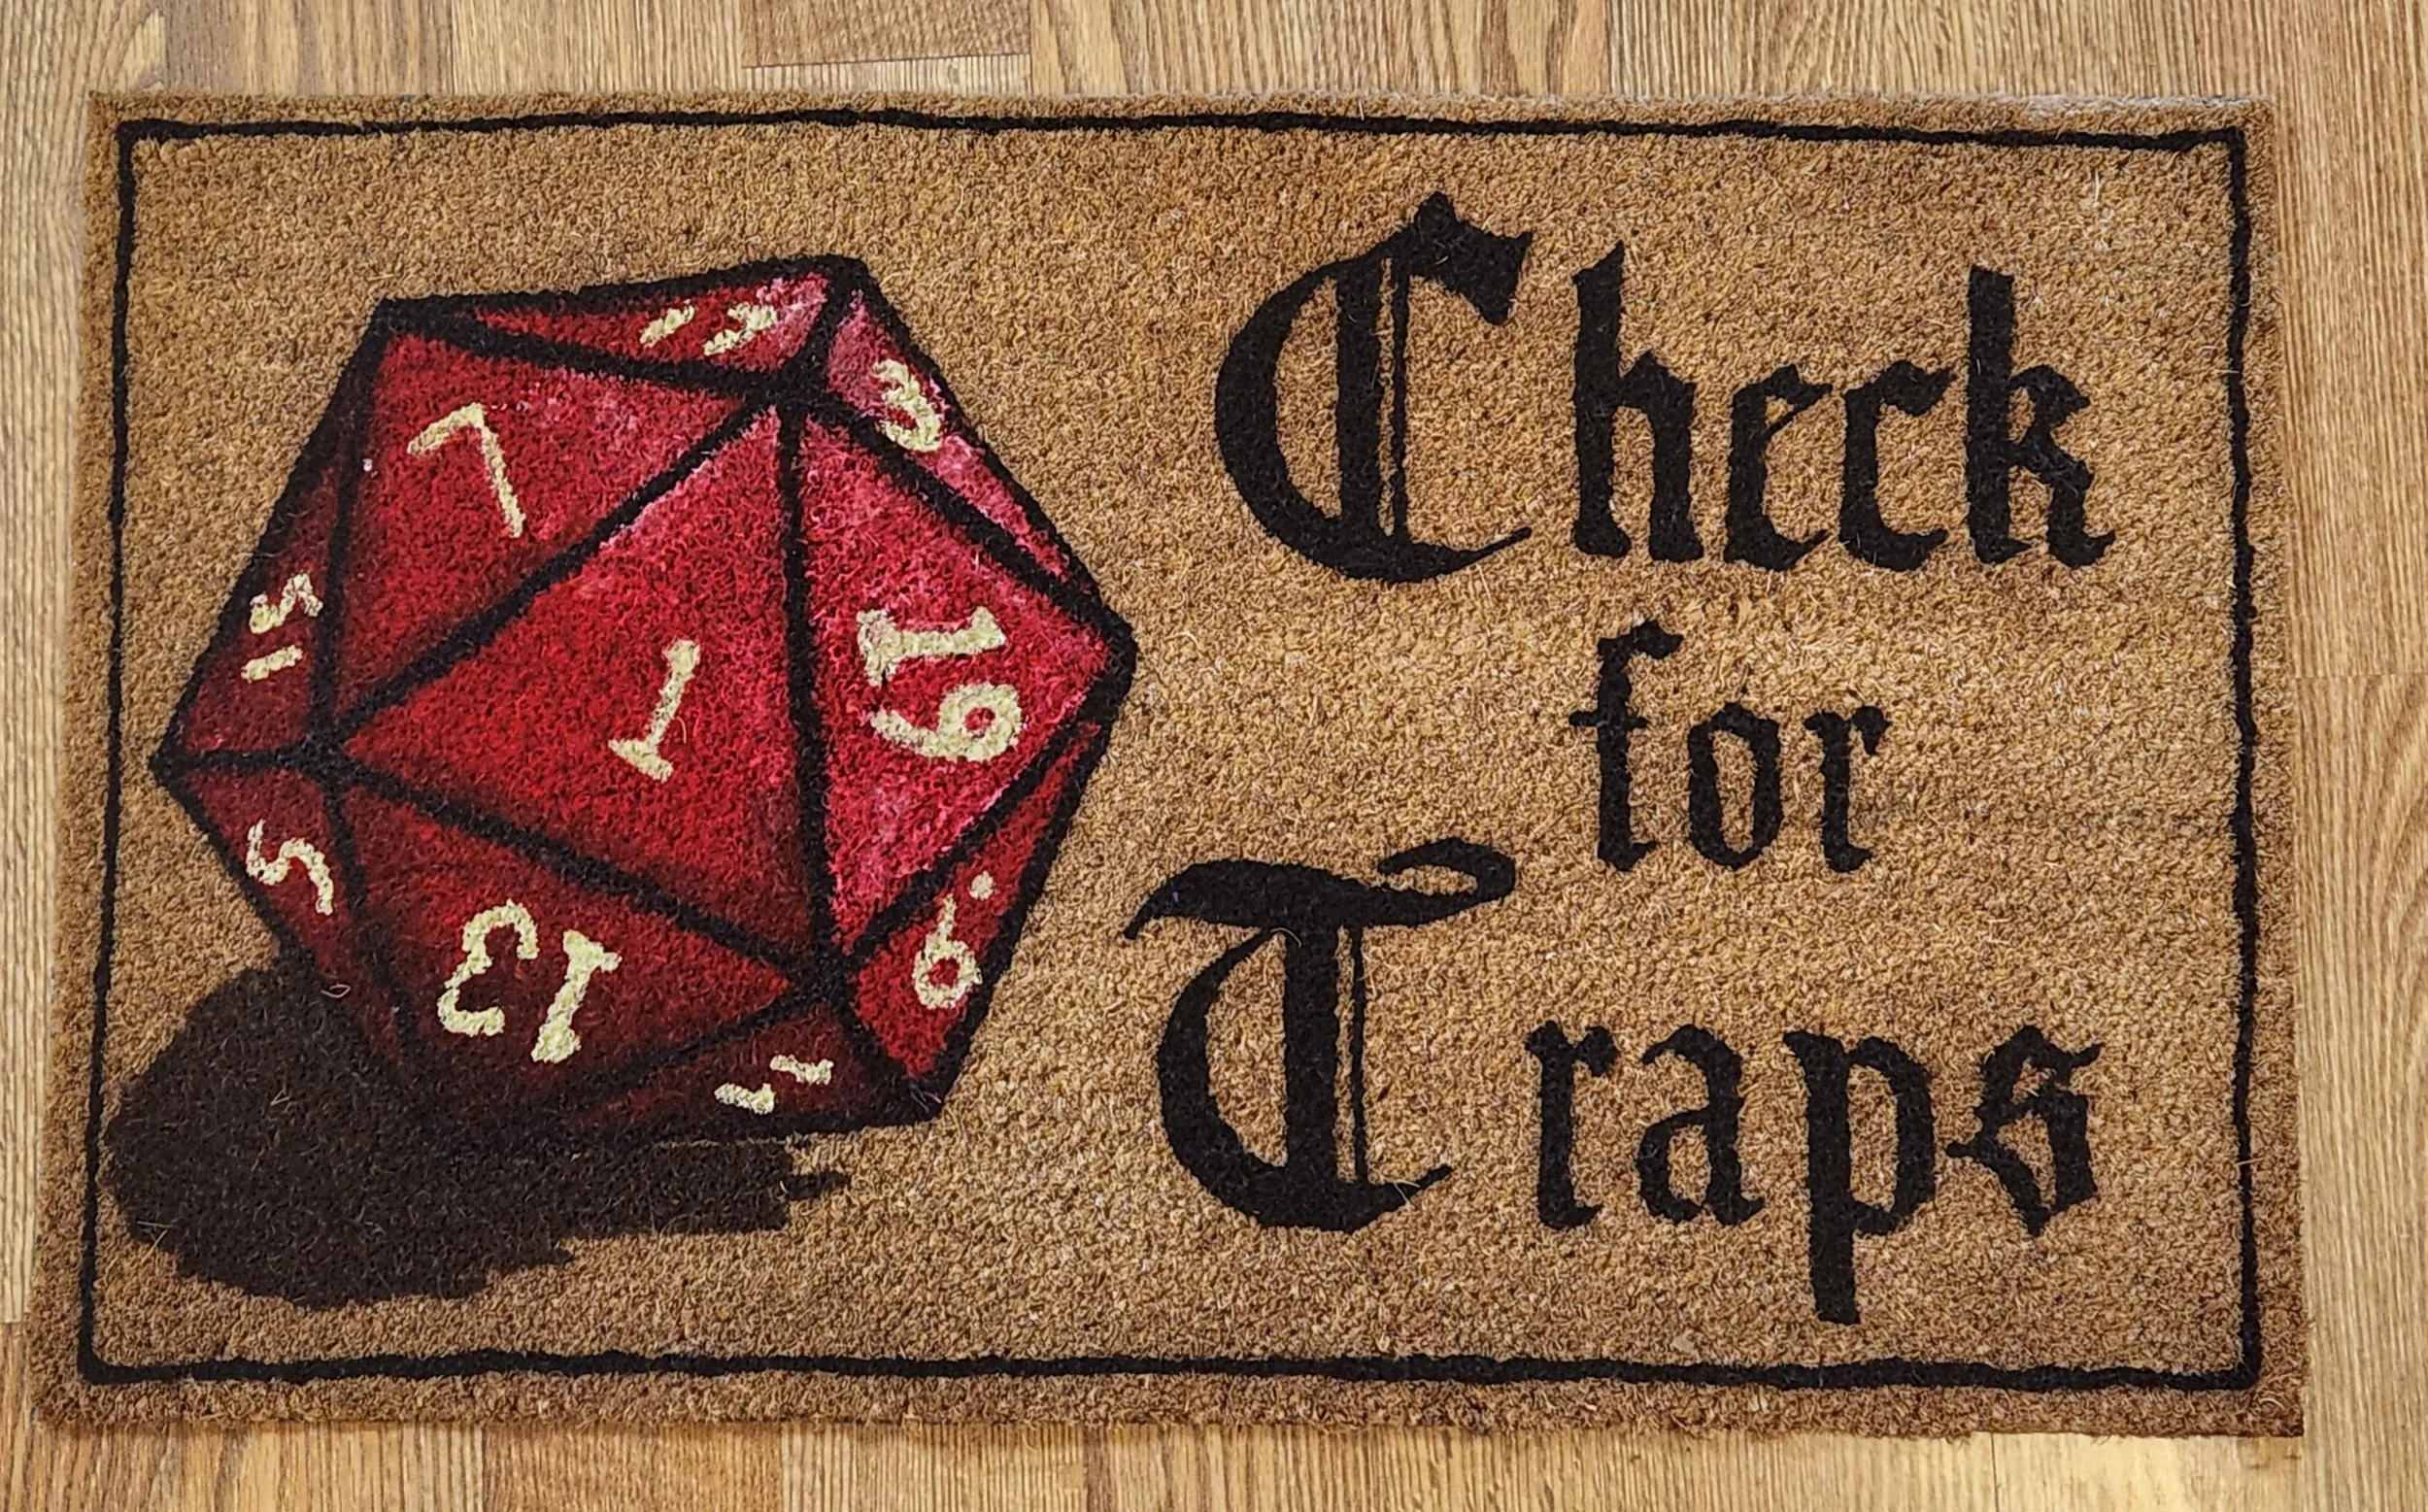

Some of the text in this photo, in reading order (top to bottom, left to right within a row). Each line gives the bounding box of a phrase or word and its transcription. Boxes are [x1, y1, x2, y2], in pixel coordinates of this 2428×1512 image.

[874, 358, 947, 453] 3
[1214, 193, 2113, 583] Check
[407, 402, 525, 538] 7
[608, 639, 701, 783] 1
[857, 606, 1026, 762] 19
[1568, 619, 1891, 872] for
[437, 898, 624, 1063] 13
[1124, 838, 2101, 1325] Traps
